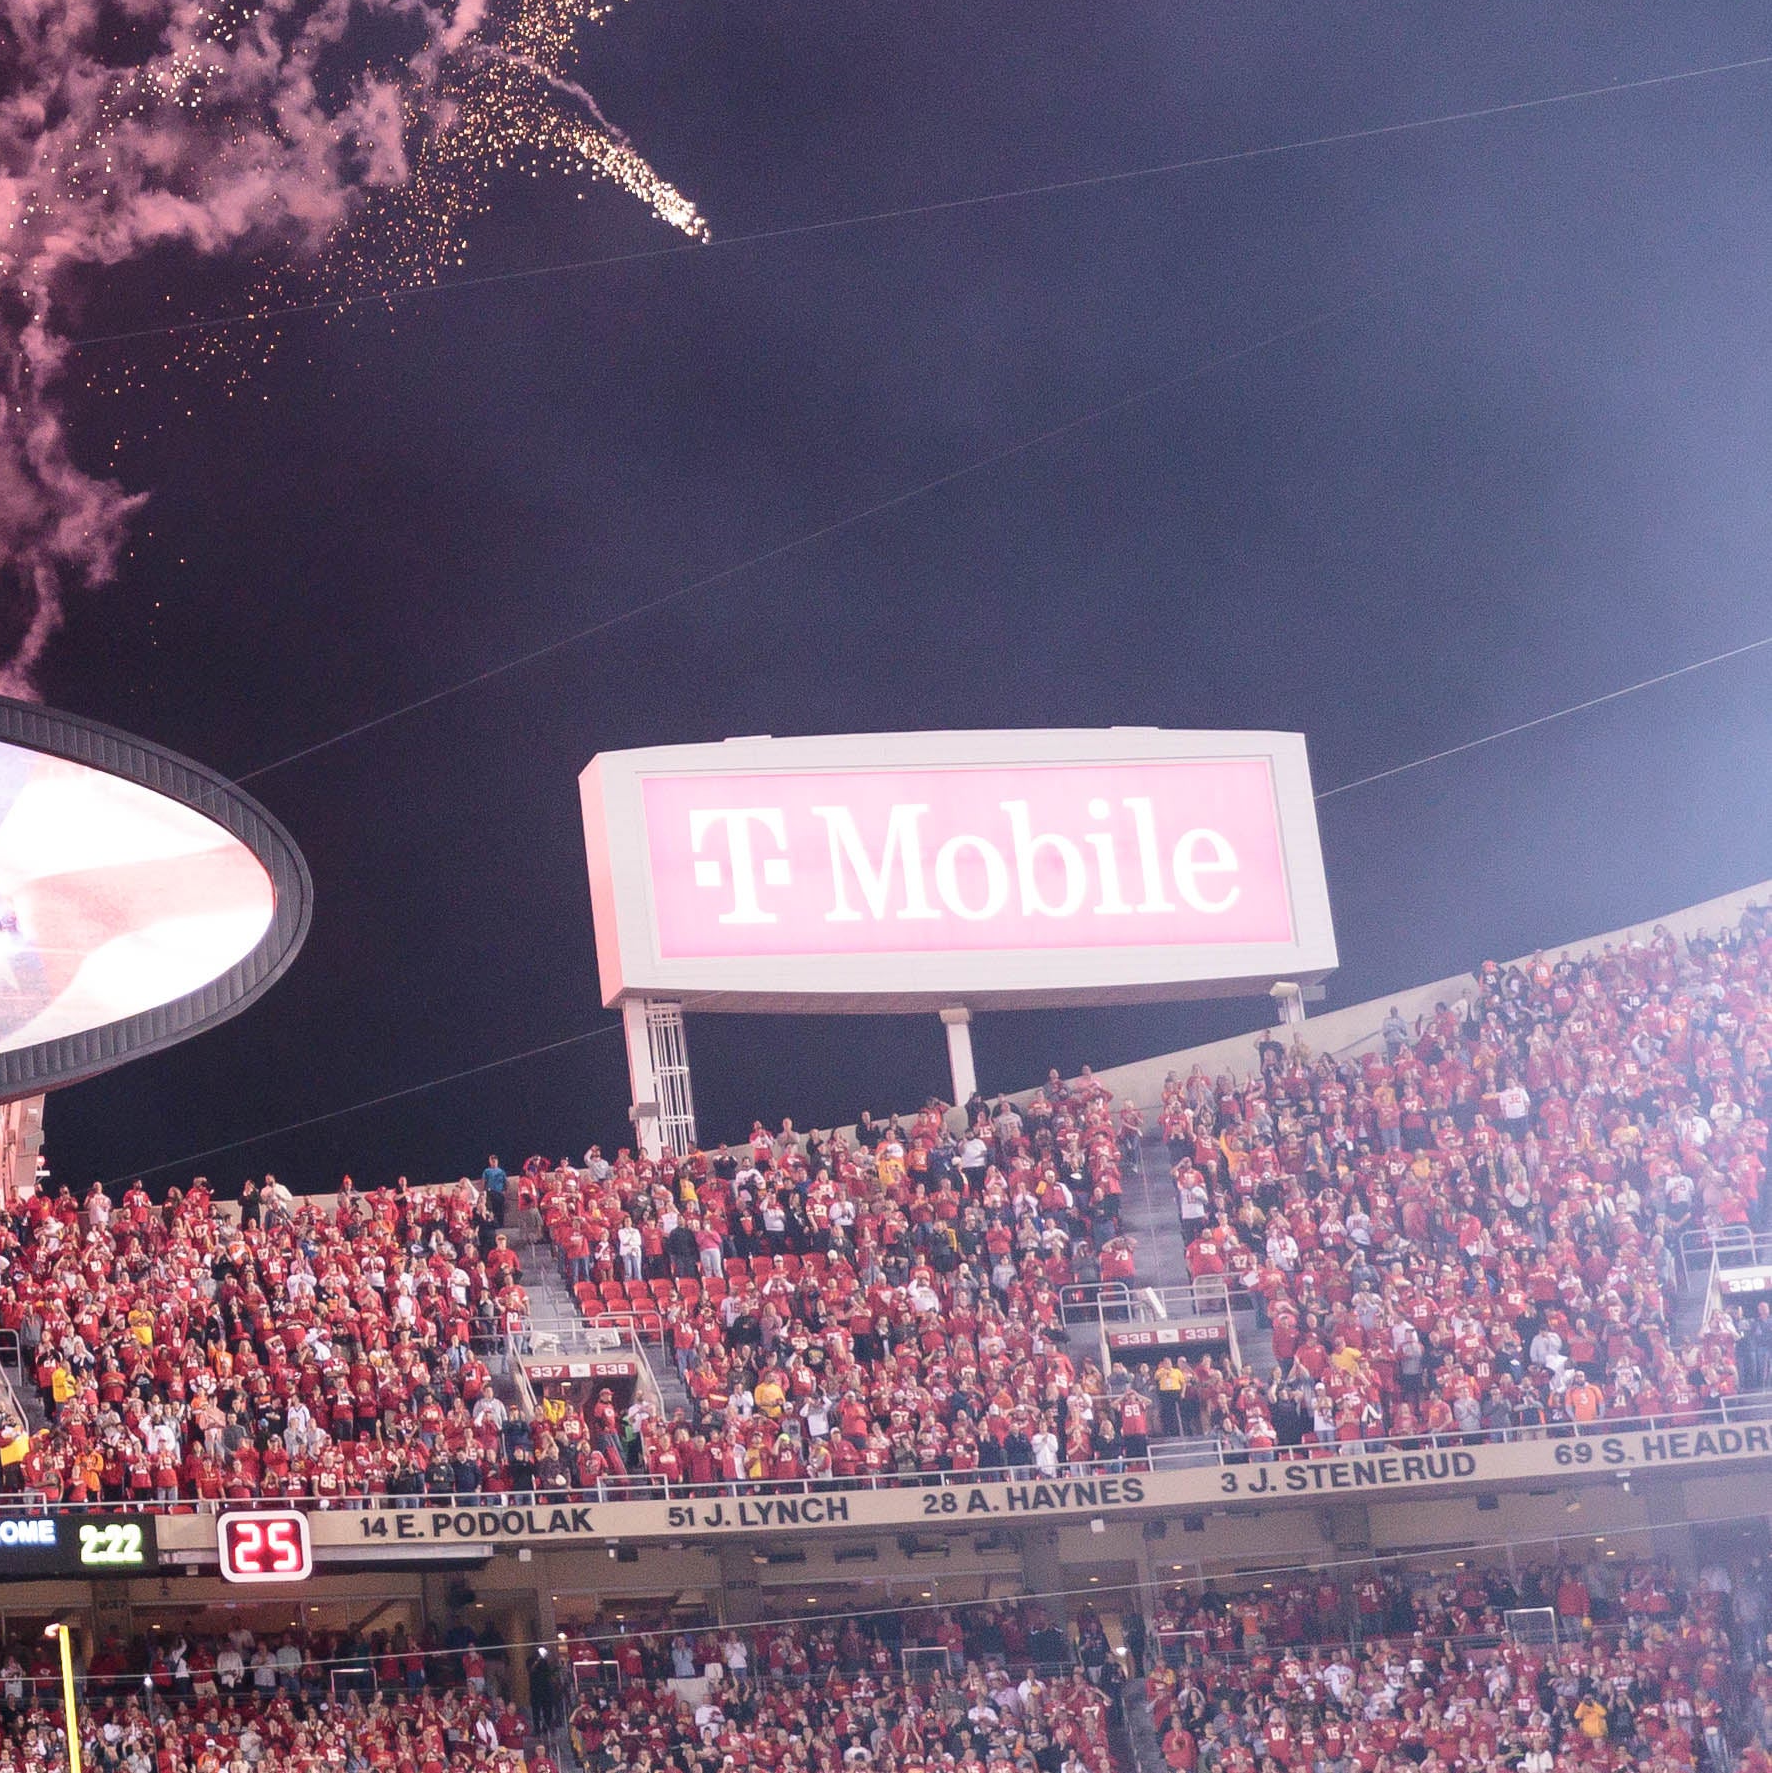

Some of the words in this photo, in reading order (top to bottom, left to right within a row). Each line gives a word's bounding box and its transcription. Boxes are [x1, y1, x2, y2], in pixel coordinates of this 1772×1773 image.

[811, 796, 1240, 922] Mobile
[530, 1365, 563, 1379] 337
[1555, 1443, 1592, 1465] 69
[1602, 1439, 1635, 1464] S.
[1642, 1424, 1772, 1462] HEADR
[1221, 1473, 1238, 1493] 3
[1248, 1468, 1277, 1493] J.
[1285, 1451, 1476, 1491] STENERUD
[669, 1507, 695, 1527] 51
[704, 1504, 731, 1527] J.
[739, 1496, 848, 1526] LYNCH
[923, 1492, 957, 1515] 28
[967, 1489, 999, 1513] A.
[1007, 1477, 1146, 1511] HAYNES
[360, 1517, 388, 1537] 14
[396, 1514, 424, 1538] E.
[433, 1508, 593, 1538] PODOLAK
[79, 1524, 144, 1564] 2:22
[234, 1521, 299, 1573] 25
